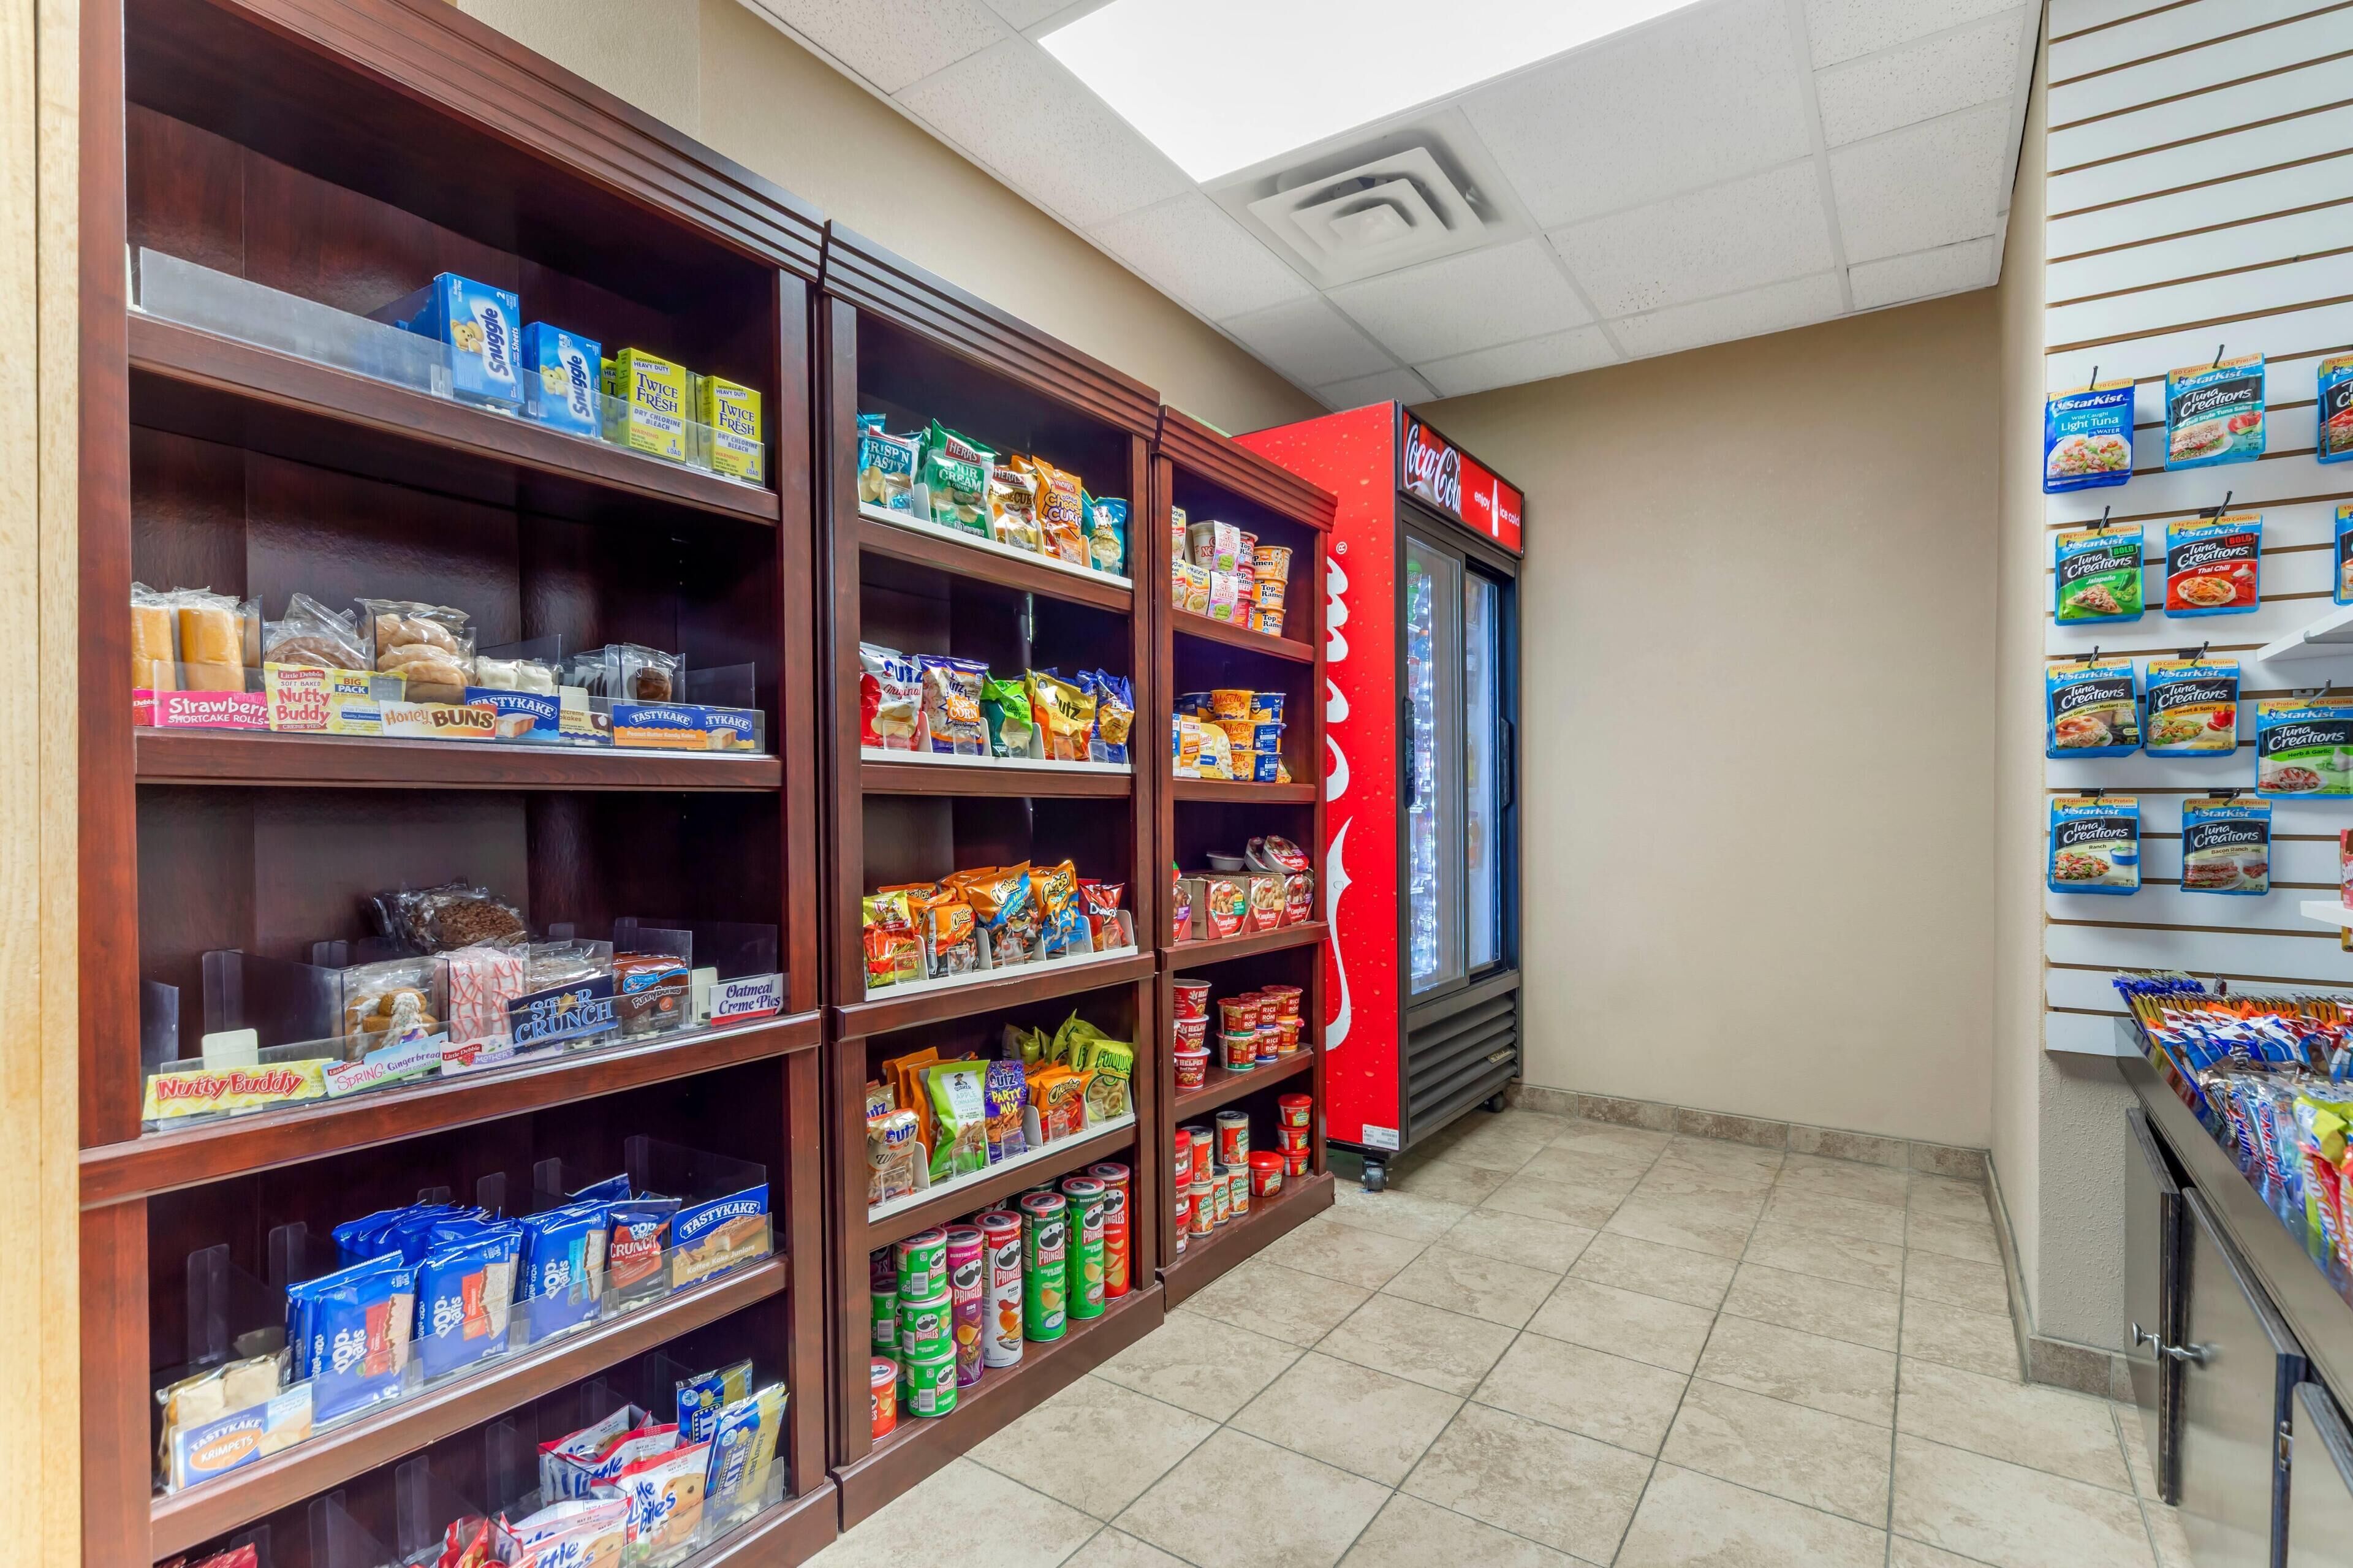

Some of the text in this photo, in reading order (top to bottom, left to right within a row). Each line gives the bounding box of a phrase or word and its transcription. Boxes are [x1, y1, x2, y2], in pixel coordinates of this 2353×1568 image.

[480, 308, 509, 376] Snuggle
[637, 372, 678, 399] TWICE
[2186, 370, 2243, 385] StarKist
[567, 355, 590, 417] Snuggle
[637, 386, 678, 413] FRESH
[2064, 393, 2123, 409] StarKist
[2180, 389, 2252, 417] Creations
[2186, 388, 2218, 403] Tuna
[634, 408, 681, 428] DRY CHLORINE
[719, 399, 754, 422] TWICE
[646, 418, 670, 431] BLEACH
[719, 412, 755, 436] FRESH
[2061, 417, 2119, 431] Light Tuna
[2186, 417, 2198, 426] Deli
[2199, 412, 2215, 422] Style
[631, 427, 659, 439] WARNING
[672, 438, 676, 447] 1
[728, 442, 748, 453] BLEACH
[731, 436, 758, 450] CHLORINE
[667, 447, 681, 456] LOAD
[949, 442, 977, 461] HERR'S
[868, 454, 906, 472] TASTY
[1405, 424, 1461, 516] Coca-Cola
[939, 469, 981, 491] CREAM
[1474, 491, 1490, 510] enjoy
[1508, 513, 1520, 527] cold
[2188, 527, 2241, 537] StarKist
[2229, 535, 2252, 544] BOLD
[2076, 538, 2123, 548] StarKist
[2114, 546, 2134, 555] BOLD
[2184, 542, 2216, 555] Tuna
[2072, 554, 2102, 566] Tuna
[2177, 546, 2249, 567] Creations
[2067, 556, 2132, 578] Creations
[2086, 575, 2116, 585] Jalapeño
[2067, 670, 2113, 680] StarKist
[2168, 668, 2218, 677] StarKist
[277, 687, 330, 705] Nutty
[338, 685, 366, 694] PACK
[884, 684, 921, 699] Original
[2065, 684, 2095, 697] Tuna
[2164, 684, 2196, 695] Tuna
[2061, 689, 2124, 709] Creations
[2158, 689, 2228, 708] Creations
[276, 704, 330, 723] Buddy
[469, 697, 555, 718] TASTYKAKE
[950, 707, 977, 719] CORN
[168, 713, 263, 725] SHORTCAKE ROLLS
[384, 708, 494, 729] Honey BUNS
[631, 711, 690, 725] TASTYKAKE
[2059, 713, 2073, 721] Whole
[2276, 725, 2311, 738] Tuna
[2269, 732, 2345, 751] Creations
[2063, 827, 2128, 843] Creations
[2069, 821, 2098, 833] Tuna
[2199, 824, 2230, 835] Tuna
[2194, 831, 2259, 847] Creations
[952, 909, 971, 930] Cheetos
[726, 980, 774, 999] Oatmeal
[719, 994, 781, 1015] Creme Pies
[515, 1000, 613, 1043] CRUNCH
[460, 1045, 481, 1055] Debbie
[387, 1051, 441, 1071] Gingerbread
[338, 1062, 384, 1091] SPRING
[157, 1077, 229, 1100] Nutty
[230, 1070, 304, 1096] Buddy
[1049, 1078, 1081, 1105] Cheetos
[991, 1089, 1021, 1103] PARTY
[999, 1101, 1018, 1115] MIX
[683, 1202, 757, 1235] TASTYKAKE
[686, 1244, 755, 1275] Koffee Kake Juniors
[930, 1264, 945, 1279] PRINGLES
[916, 1330, 938, 1341] PRINGLES
[937, 1380, 955, 1396] PRINGLES
[189, 1418, 262, 1451] TASTYKAKE
[201, 1435, 253, 1463] KRIMPETS
[638, 1491, 676, 1535] Bites
